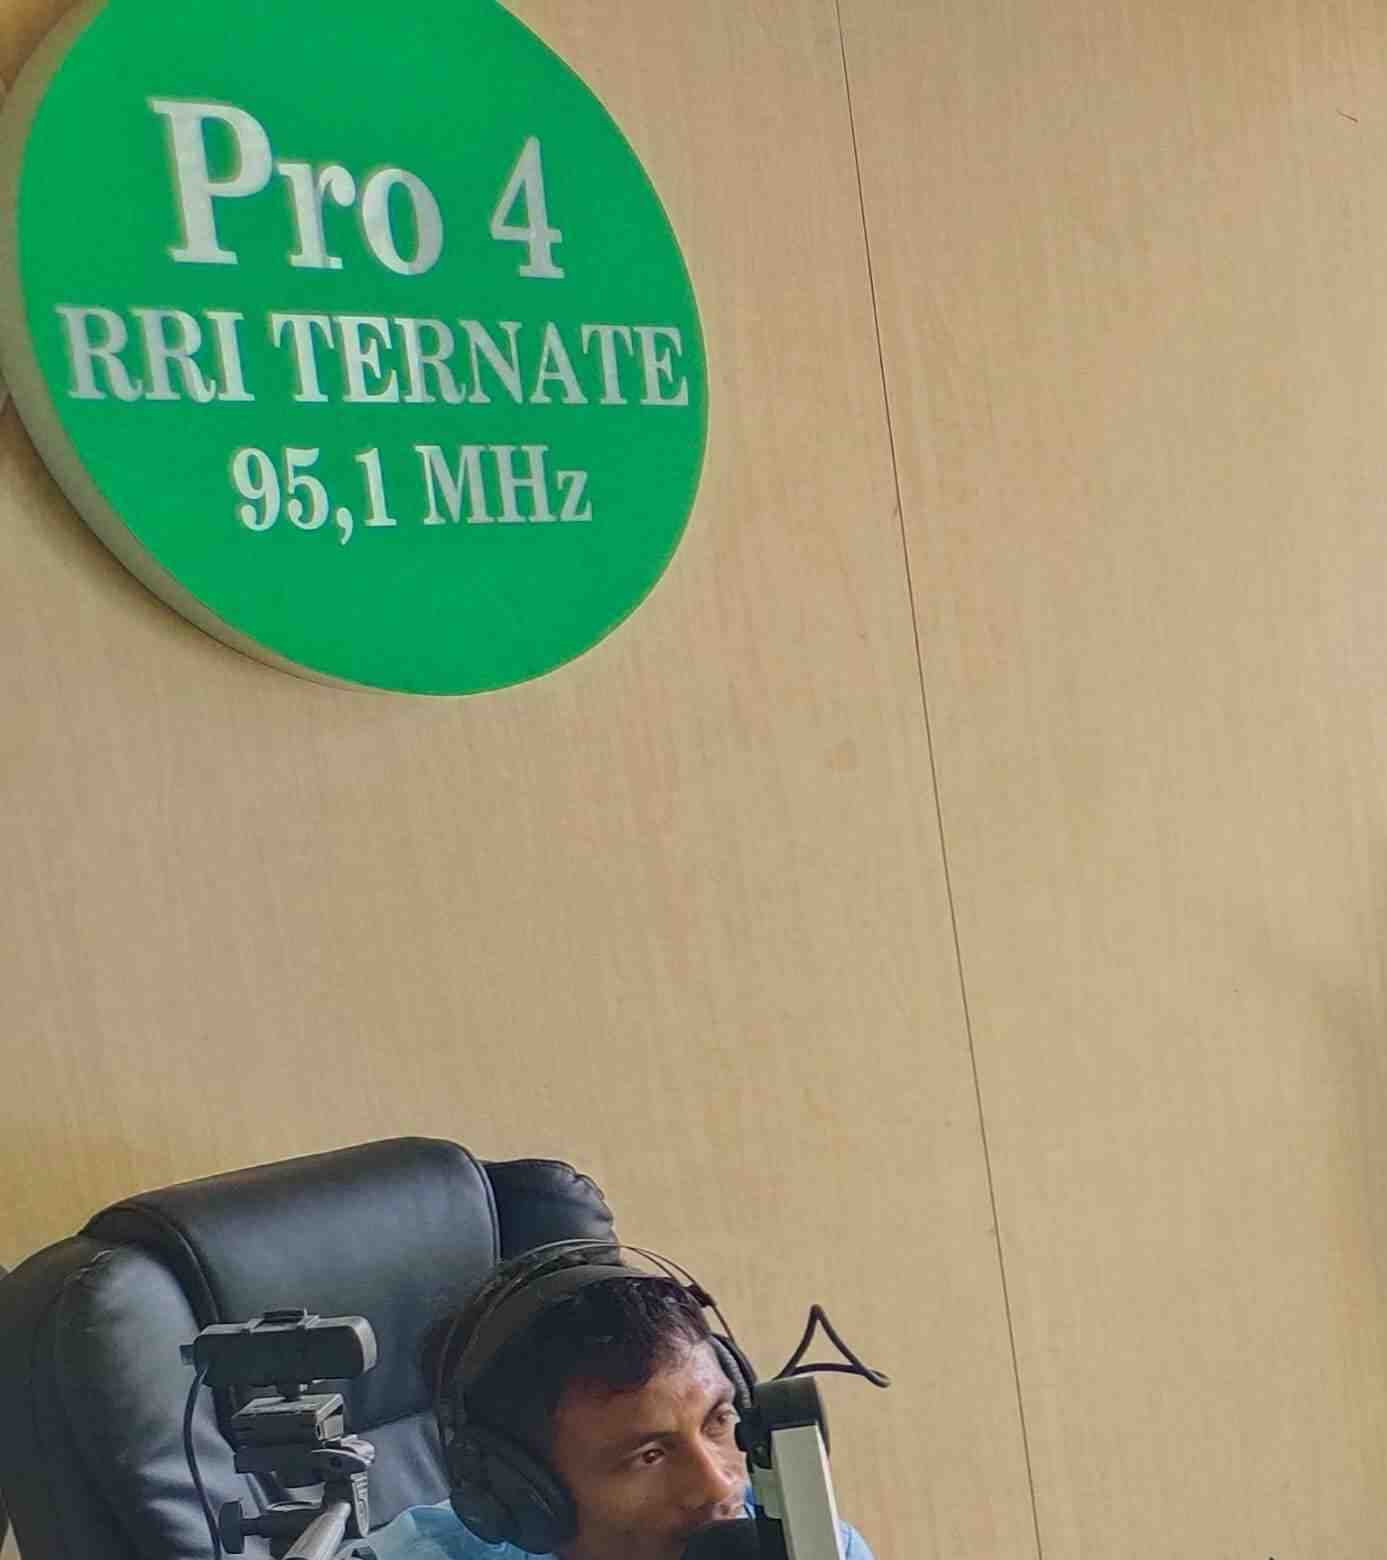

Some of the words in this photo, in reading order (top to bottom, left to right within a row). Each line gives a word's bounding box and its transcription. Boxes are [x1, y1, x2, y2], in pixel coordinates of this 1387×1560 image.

[147, 96, 444, 276] Pro
[489, 136, 565, 279] 4
[55, 303, 256, 403] RRI
[272, 312, 690, 407] TERNATE
[231, 446, 398, 546] 95,1
[414, 444, 593, 526] MHz
